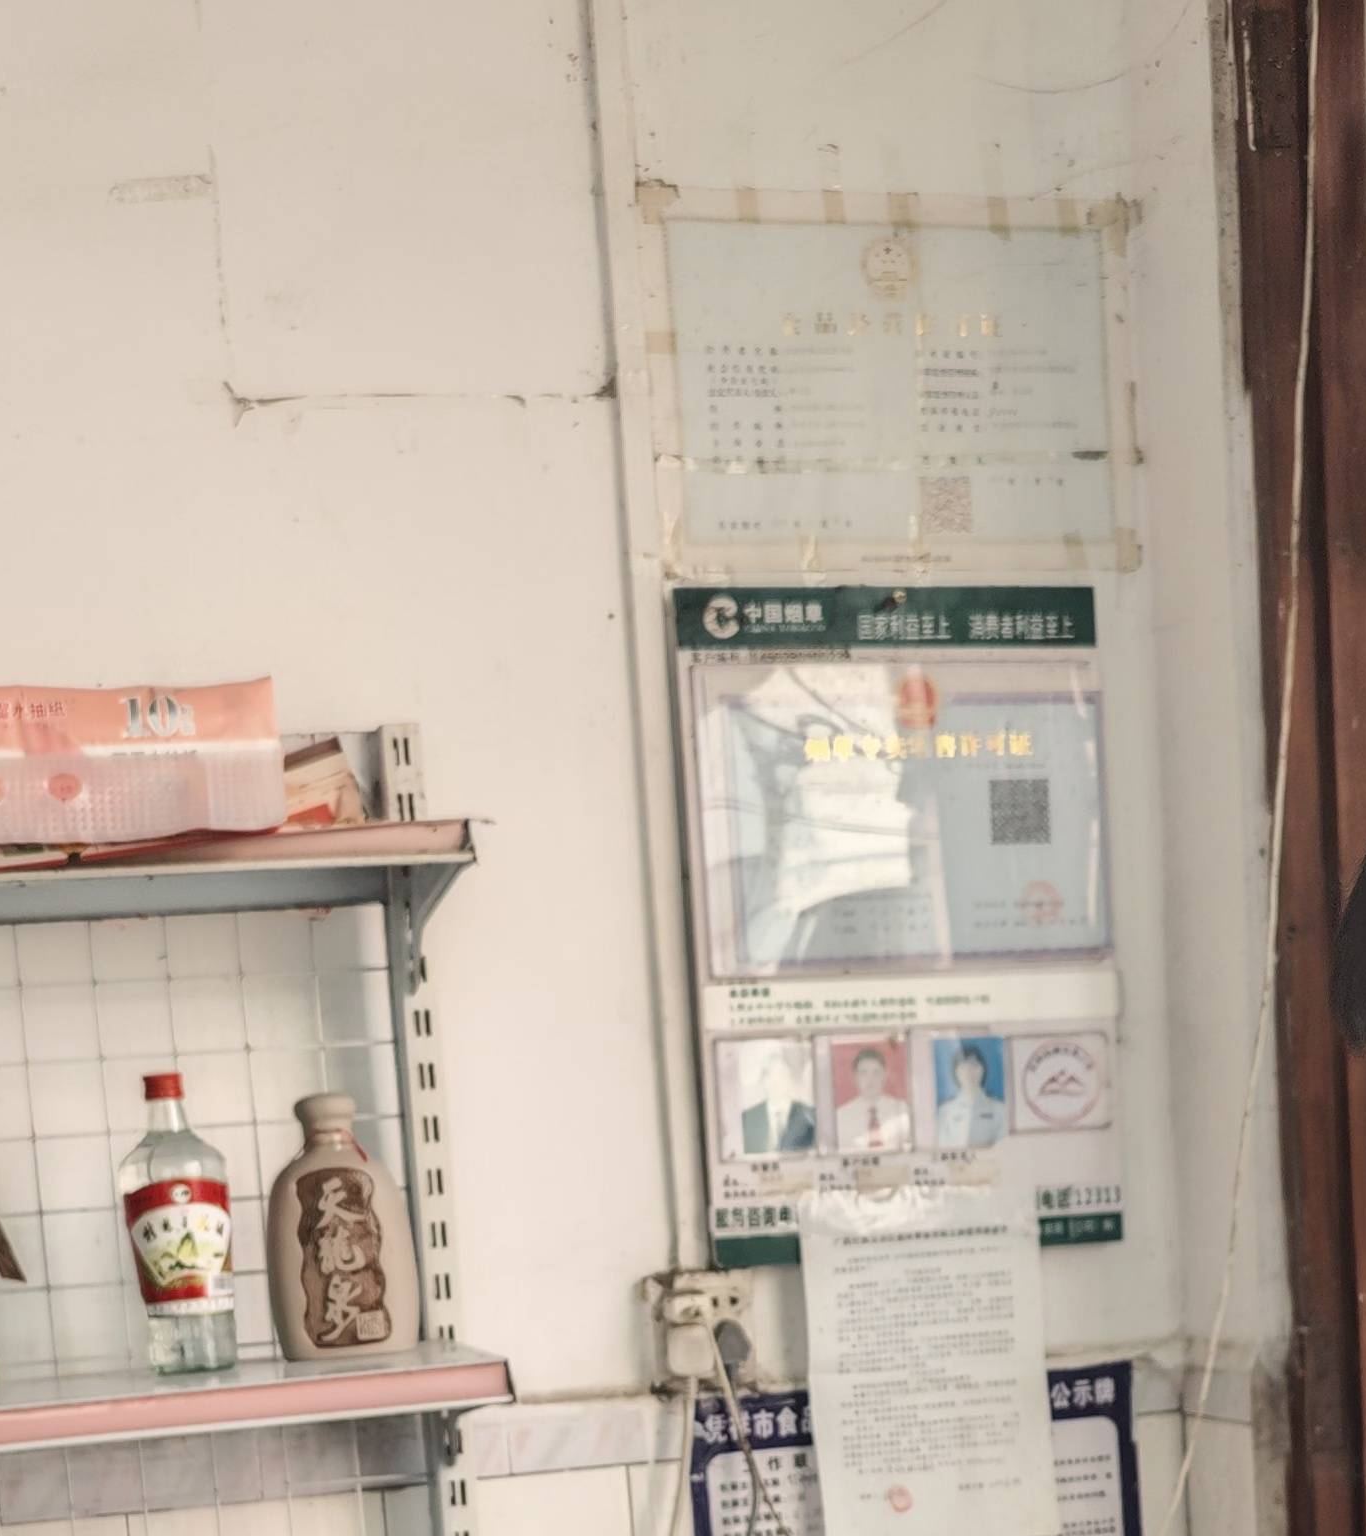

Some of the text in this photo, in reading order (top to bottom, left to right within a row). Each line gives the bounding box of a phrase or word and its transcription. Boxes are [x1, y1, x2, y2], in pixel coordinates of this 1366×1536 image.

[743, 602, 825, 624] 中国烟草
[857, 612, 1076, 641] 国家利益至上 消费者利益至上
[1051, 1378, 1117, 1411] 公示牌
